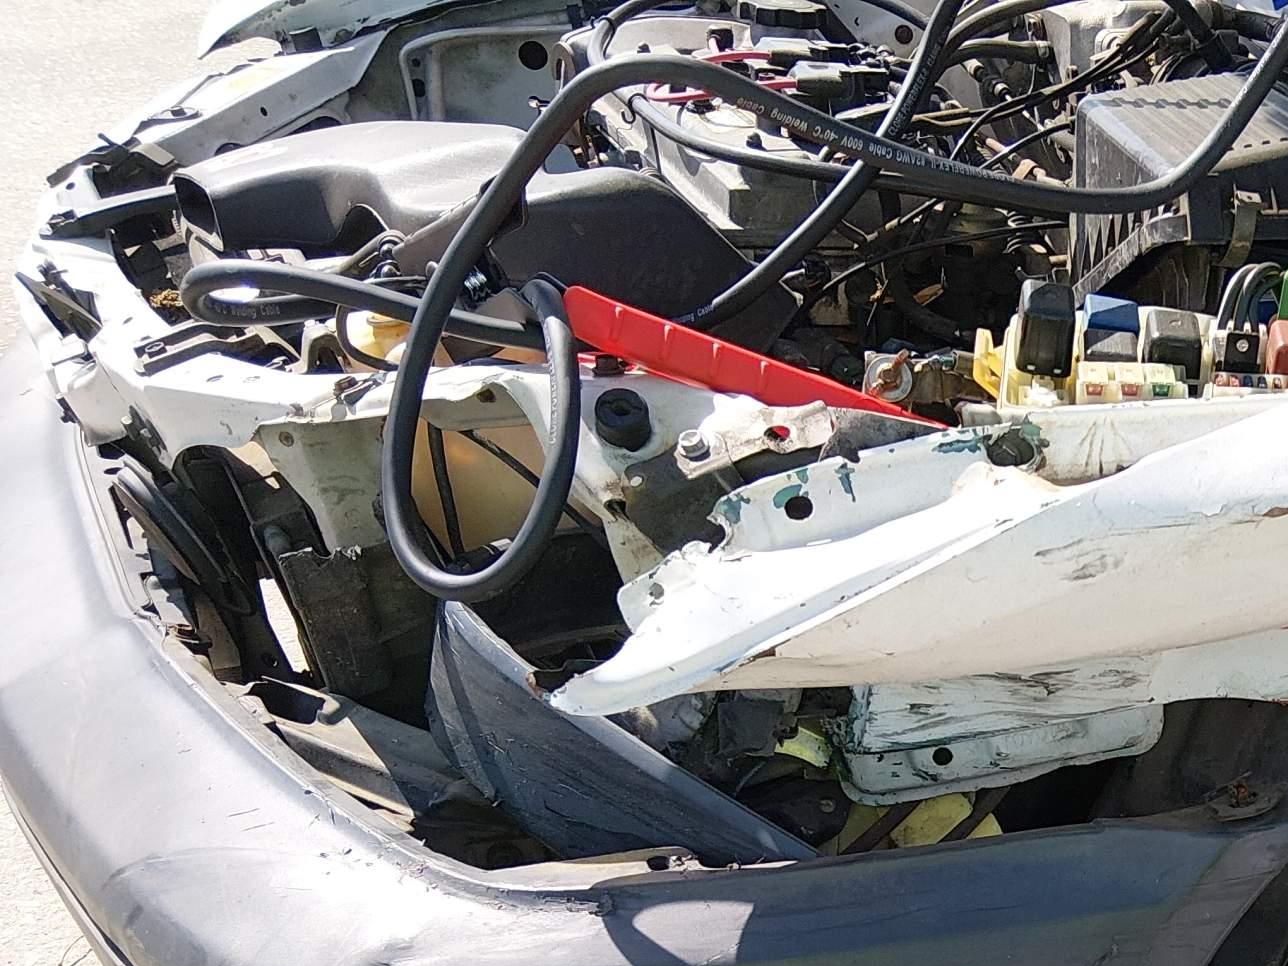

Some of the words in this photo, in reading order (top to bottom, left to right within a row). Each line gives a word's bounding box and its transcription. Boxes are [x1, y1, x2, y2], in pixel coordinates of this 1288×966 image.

[770, 108, 808, 132] Welding
[841, 137, 864, 151] 600V
[868, 142, 893, 160] Cable
